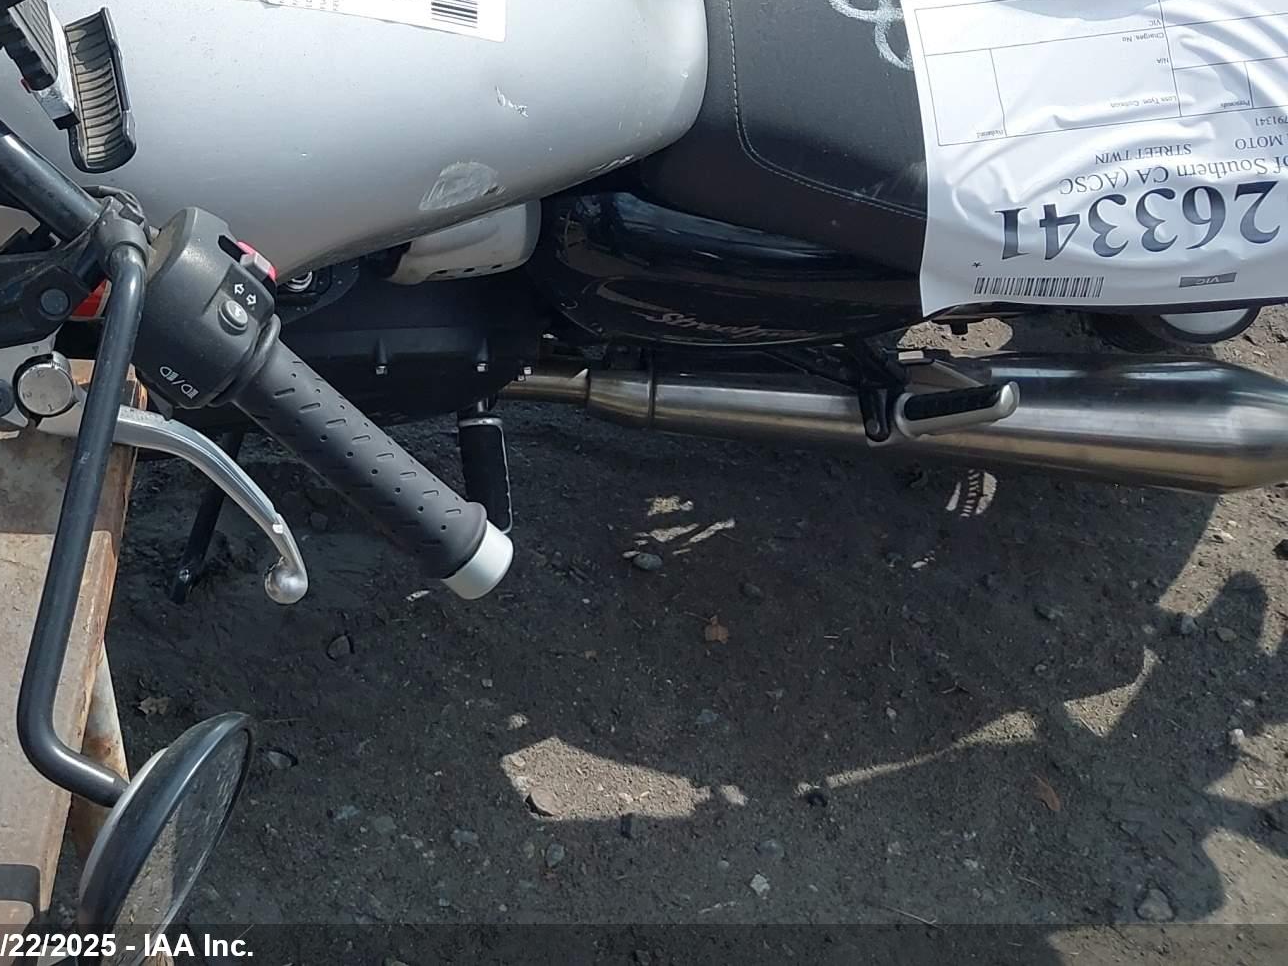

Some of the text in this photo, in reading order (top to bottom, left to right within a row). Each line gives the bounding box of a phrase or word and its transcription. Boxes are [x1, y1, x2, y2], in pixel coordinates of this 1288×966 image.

[1156, 56, 1169, 66] N/A
[1160, 94, 1178, 104] Loss
[1094, 133, 1283, 165] MOTO STREET TWIN
[1135, 167, 1169, 185] CA
[1176, 156, 1265, 182] Southern
[1057, 165, 1130, 196] (ACSC
